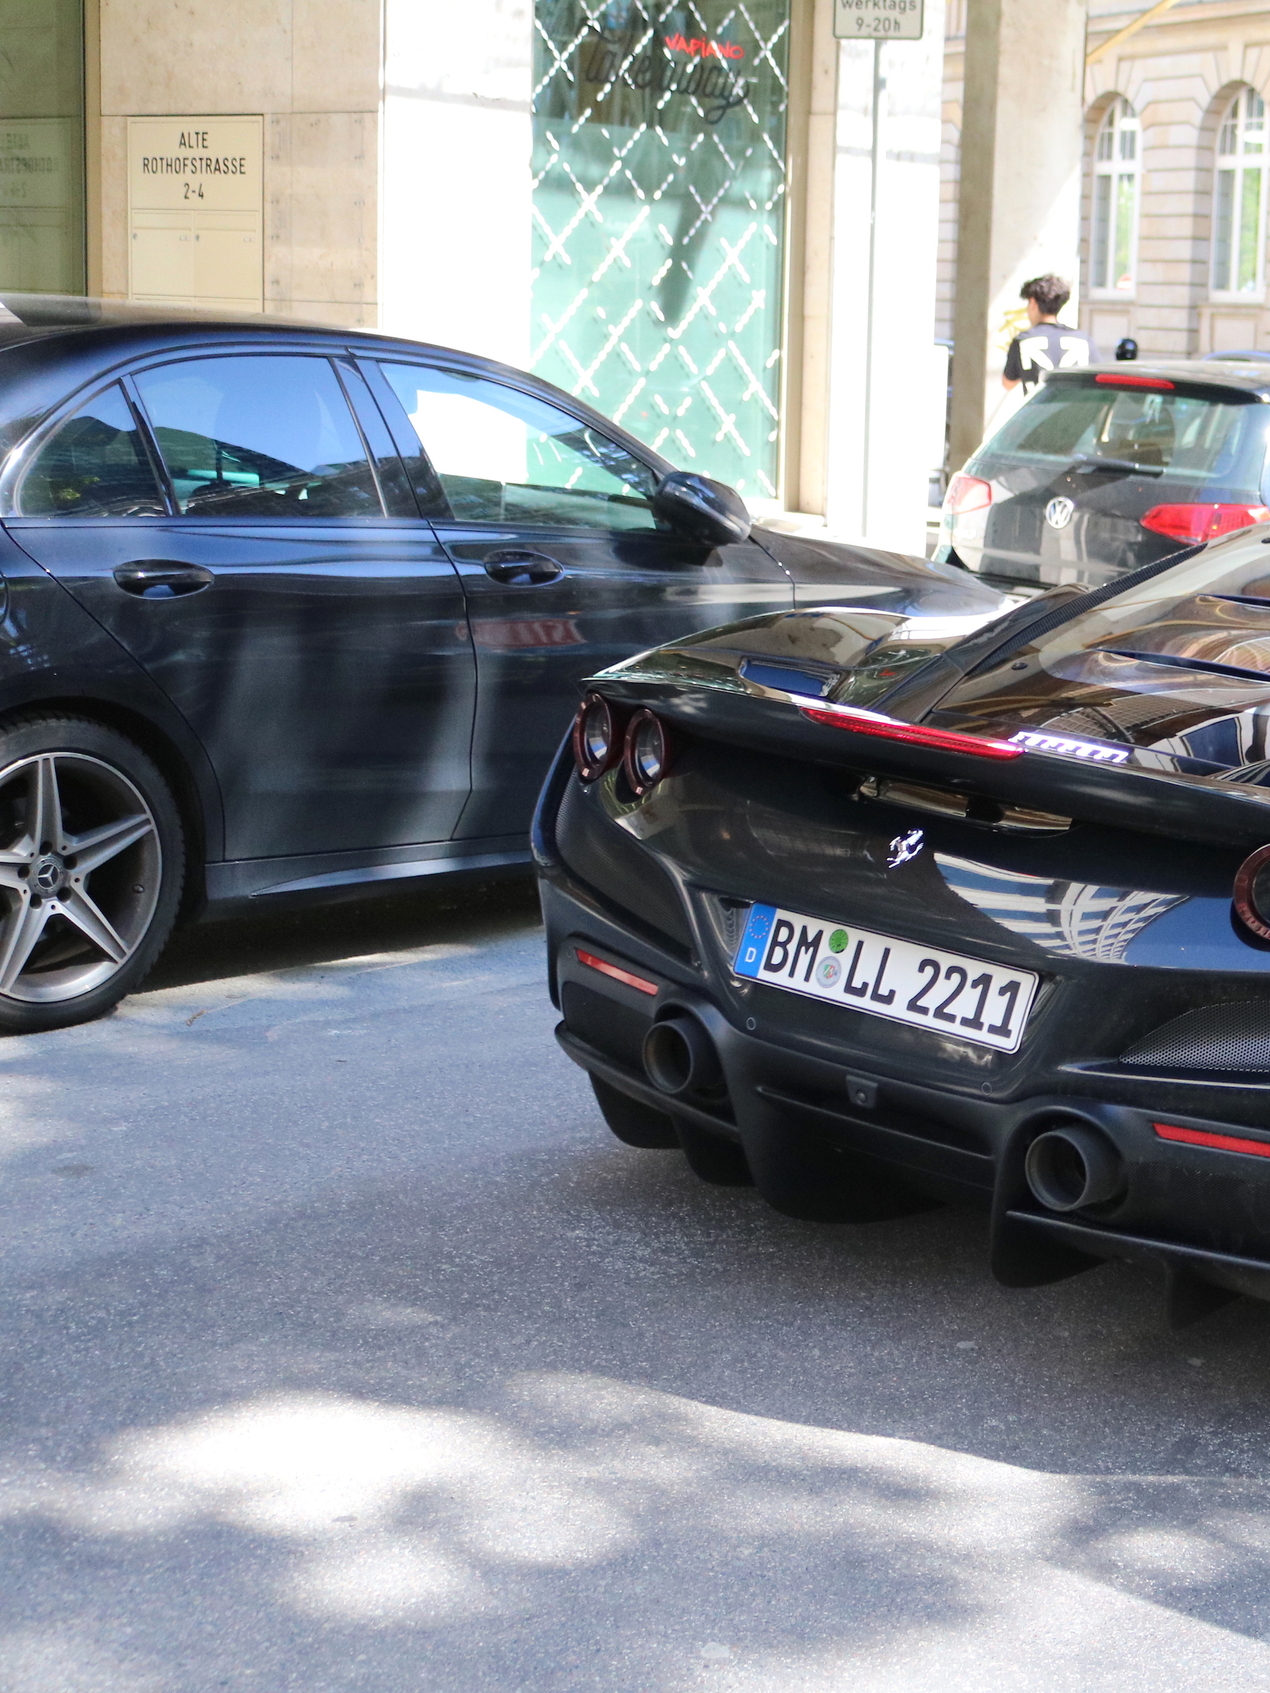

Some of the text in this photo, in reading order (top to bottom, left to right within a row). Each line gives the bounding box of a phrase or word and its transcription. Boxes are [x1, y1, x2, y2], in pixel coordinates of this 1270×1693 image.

[841, 0, 917, 15] werktags
[856, 17, 901, 33] 9-20h
[179, 132, 209, 149] ALTE
[142, 157, 246, 175] ROTHOFSTRASSE
[184, 183, 205, 200] 2-4
[744, 947, 757, 963] D
[762, 918, 1022, 1039] BM LL 2211
